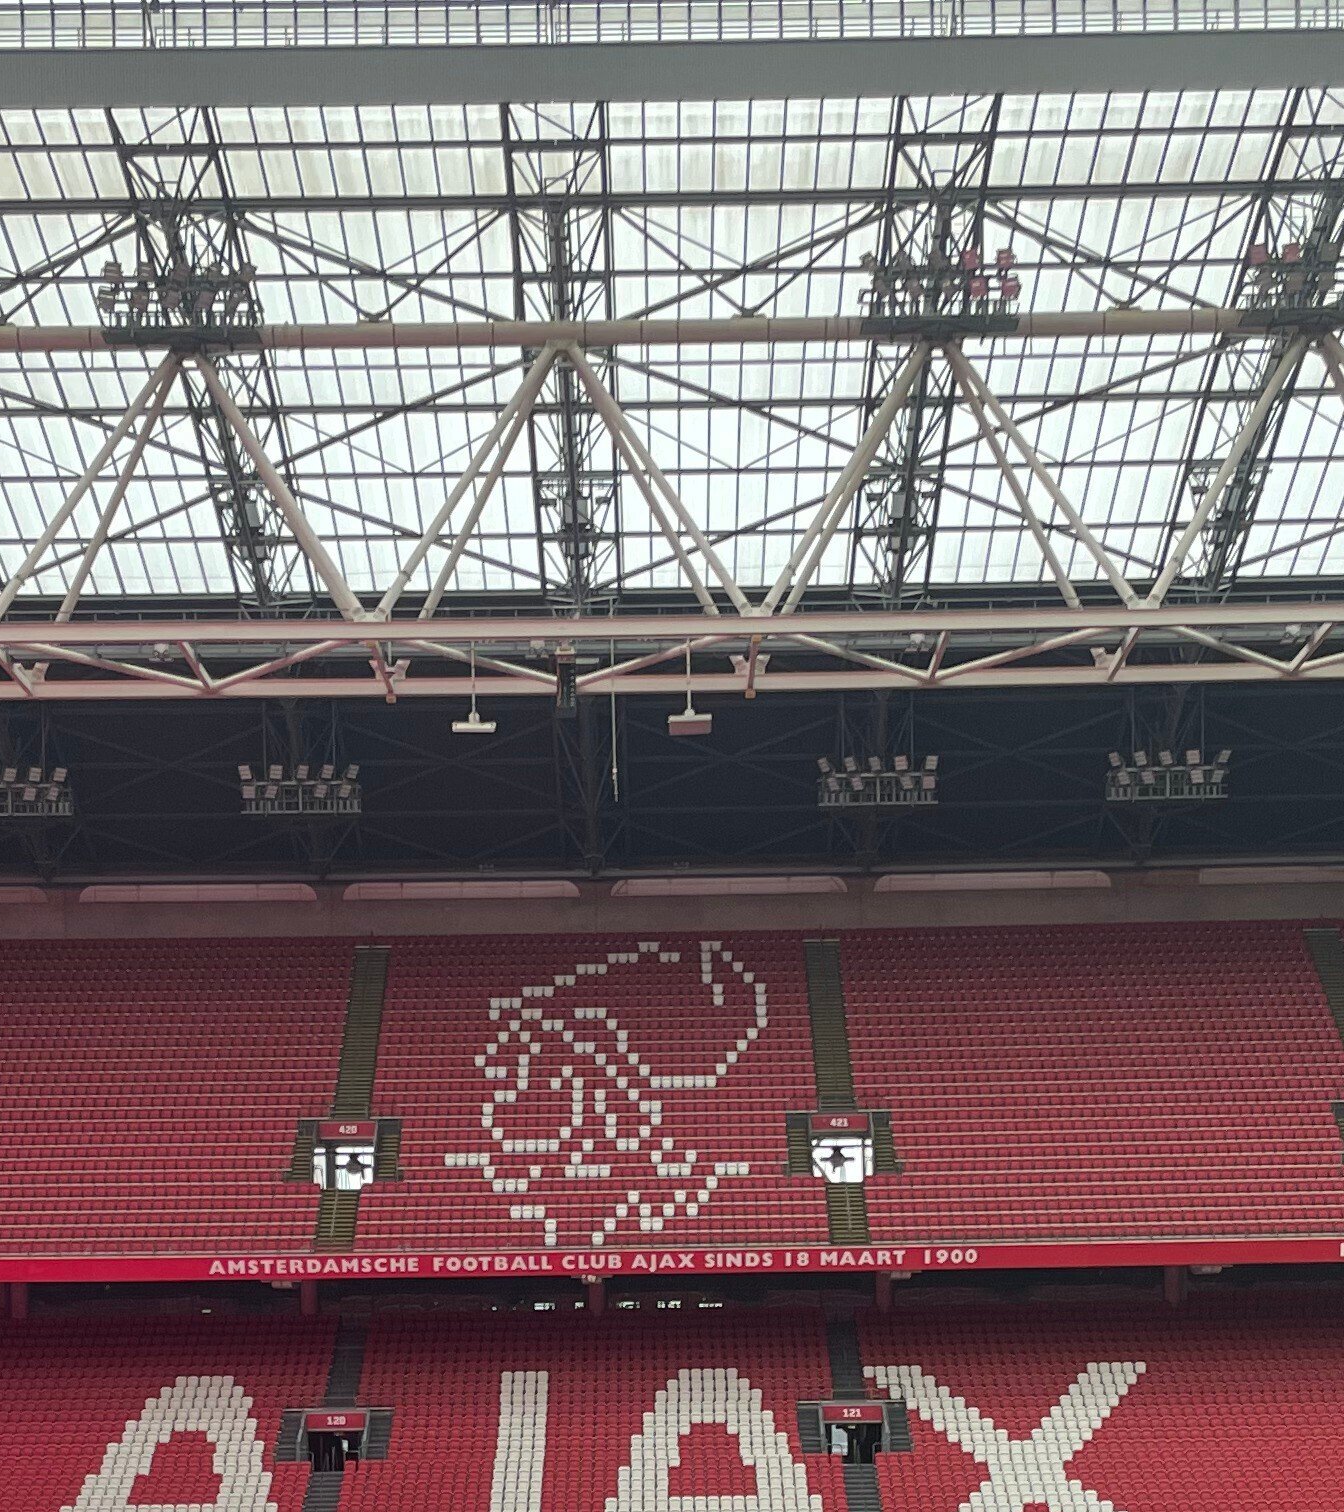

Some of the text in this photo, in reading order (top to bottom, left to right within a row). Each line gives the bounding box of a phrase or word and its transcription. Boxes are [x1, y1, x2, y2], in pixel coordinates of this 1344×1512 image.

[829, 1117, 849, 1127] 421
[209, 1248, 978, 1275] AMSTERDAMSCHE FOOTBALL CLUB AJAX SINDS 18 MAART 1900
[842, 1408, 862, 1418] 121
